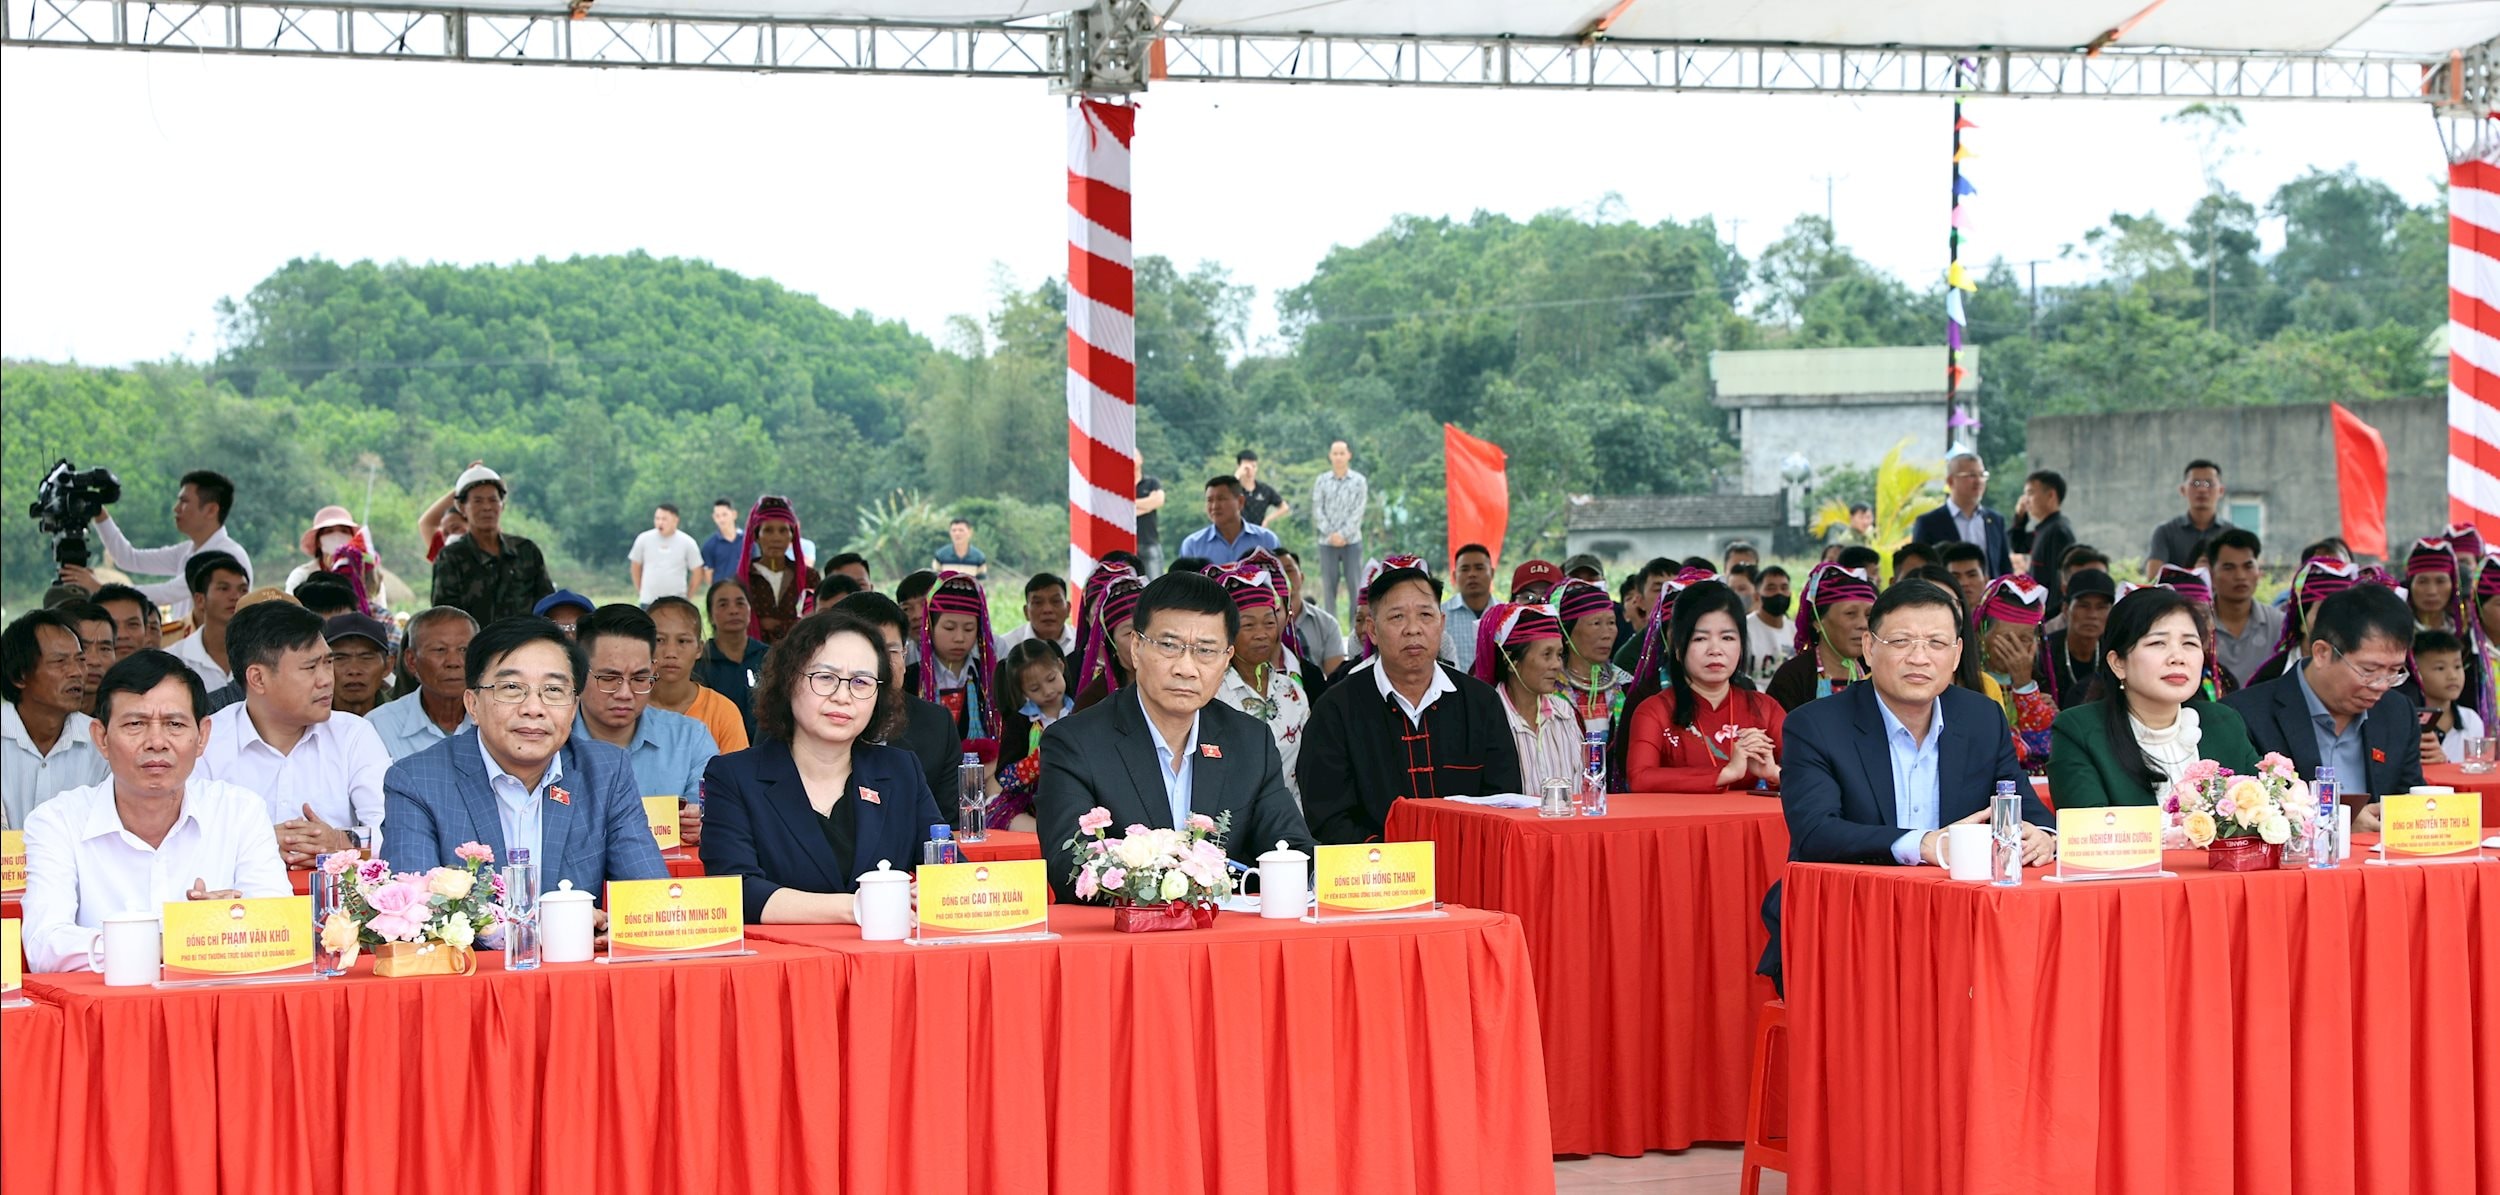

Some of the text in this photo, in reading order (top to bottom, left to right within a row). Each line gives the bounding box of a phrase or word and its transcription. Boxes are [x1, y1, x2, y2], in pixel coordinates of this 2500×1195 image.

[1393, 872, 1415, 883] THANH
[972, 893, 986, 904] CAO
[989, 892, 1000, 906] THỊ
[1002, 888, 1022, 903] XUÂN
[656, 906, 686, 922] NGUYỄN
[689, 909, 709, 921] MINH
[712, 907, 727, 920] SƠN
[221, 932, 246, 947] PHẠM
[250, 928, 267, 943] VĂN
